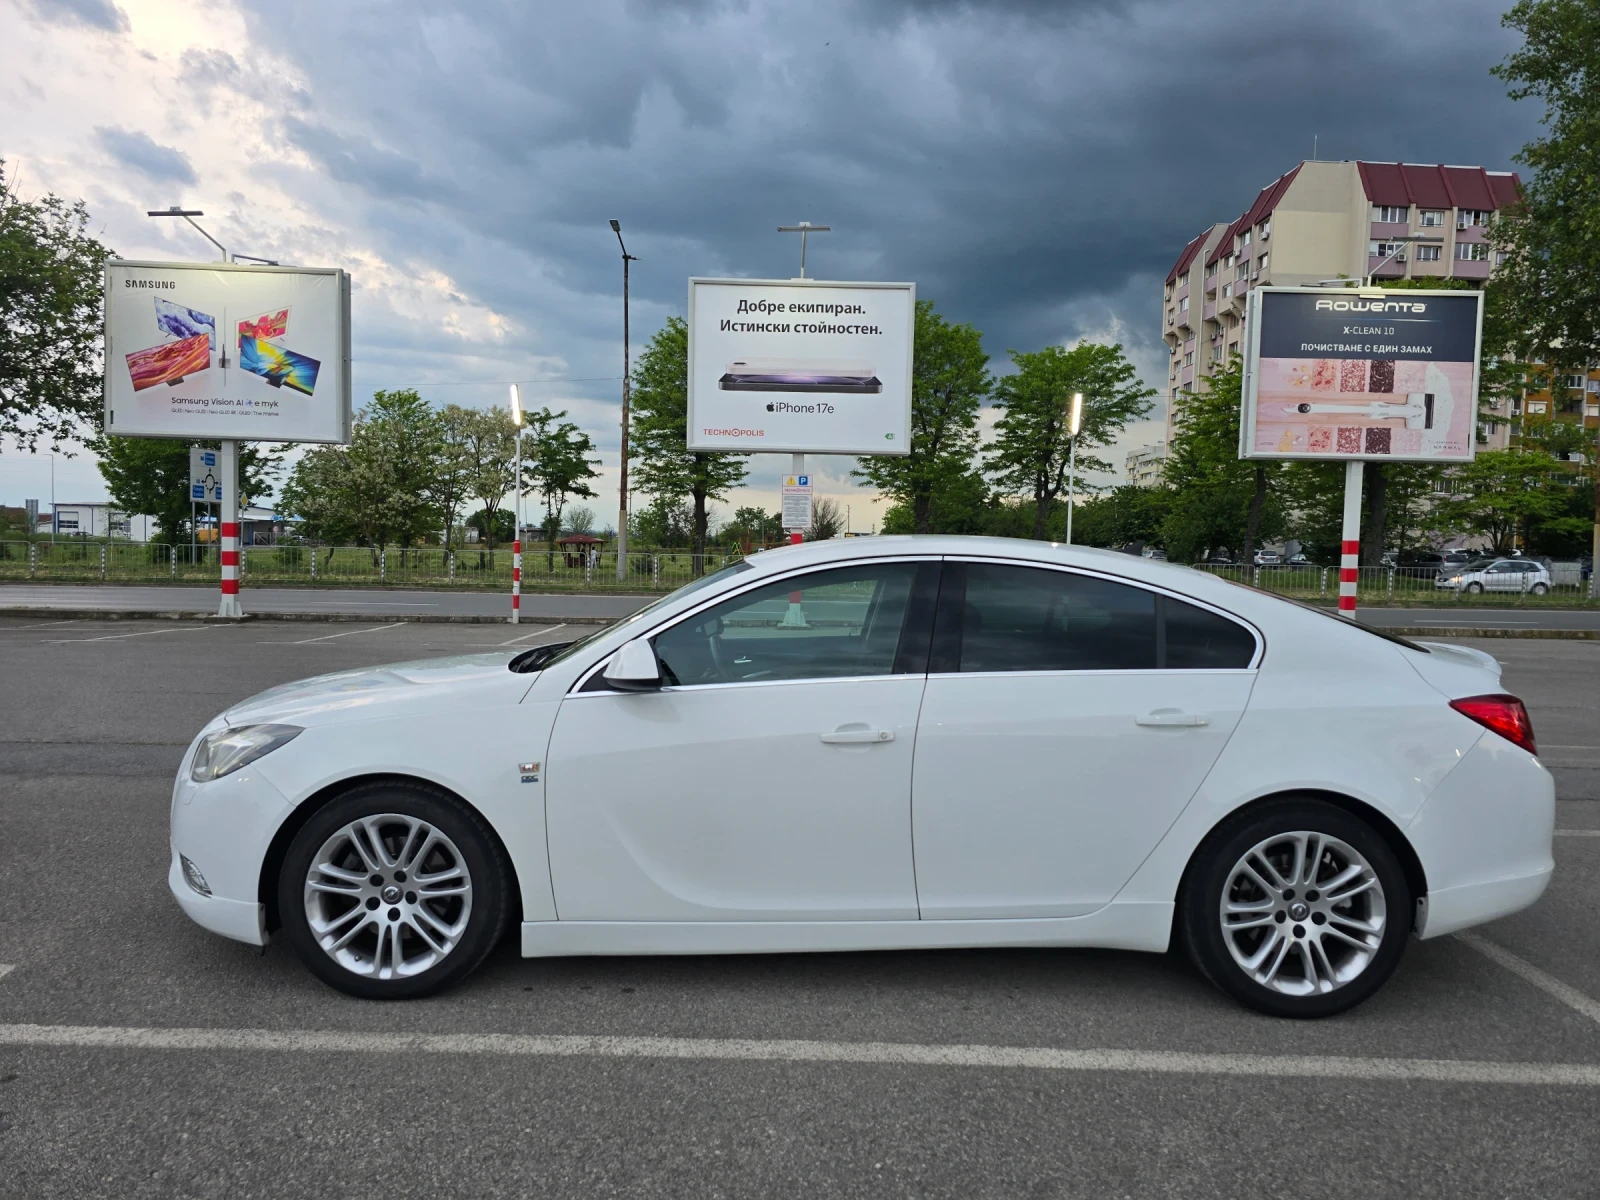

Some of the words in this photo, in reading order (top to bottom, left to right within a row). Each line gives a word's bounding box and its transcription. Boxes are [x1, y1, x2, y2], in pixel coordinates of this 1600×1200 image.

[125, 279, 176, 290] SAMSUNG
[737, 299, 785, 315] Добре
[789, 302, 866, 316] екипиран.
[720, 319, 790, 333] Истински
[794, 321, 883, 335] стойностен.
[1343, 326, 1381, 335] X-CLEAN
[1383, 327, 1395, 335] 10
[1301, 343, 1362, 352] ПОЧИСТВАНЕ
[1373, 344, 1398, 354] ЕДИН
[1400, 345, 1433, 354] ЗАМАХ
[171, 396, 209, 407] Samsung
[211, 397, 234, 406] Vision
[775, 402, 815, 413] iPhone
[816, 403, 835, 414] 17e
